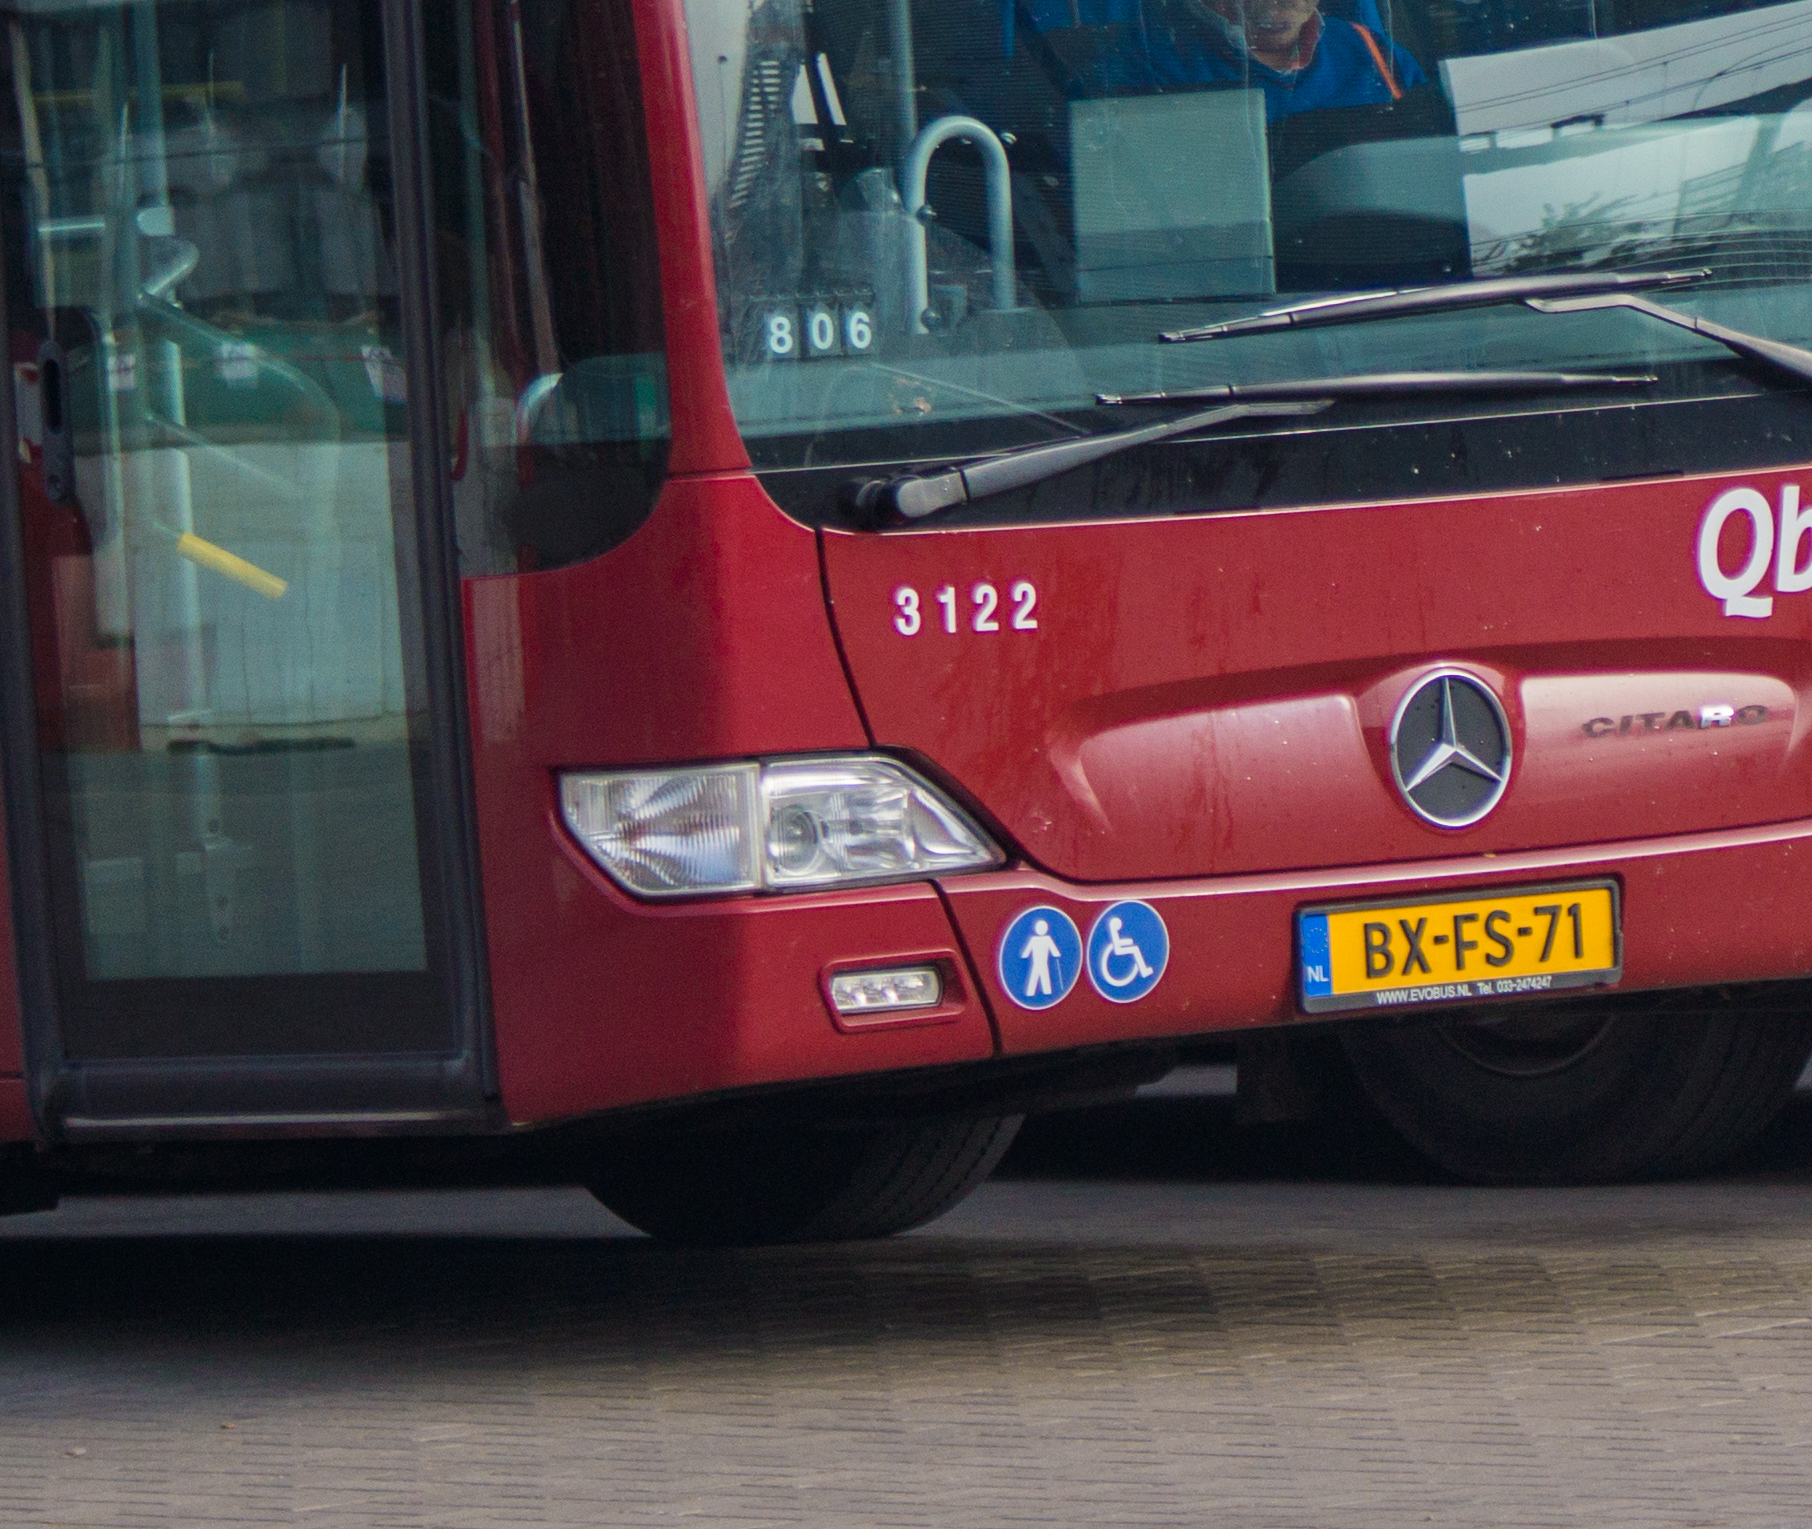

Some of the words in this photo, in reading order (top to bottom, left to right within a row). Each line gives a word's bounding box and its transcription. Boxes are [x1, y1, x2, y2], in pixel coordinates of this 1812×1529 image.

[767, 311, 872, 354] 806
[895, 581, 1038, 636] 3122
[1581, 704, 1769, 739] CITARO
[1362, 902, 1586, 980] BX-FS-71
[1307, 965, 1329, 983] NL
[1376, 983, 1473, 1005] WWW.EVOBUS.NL
